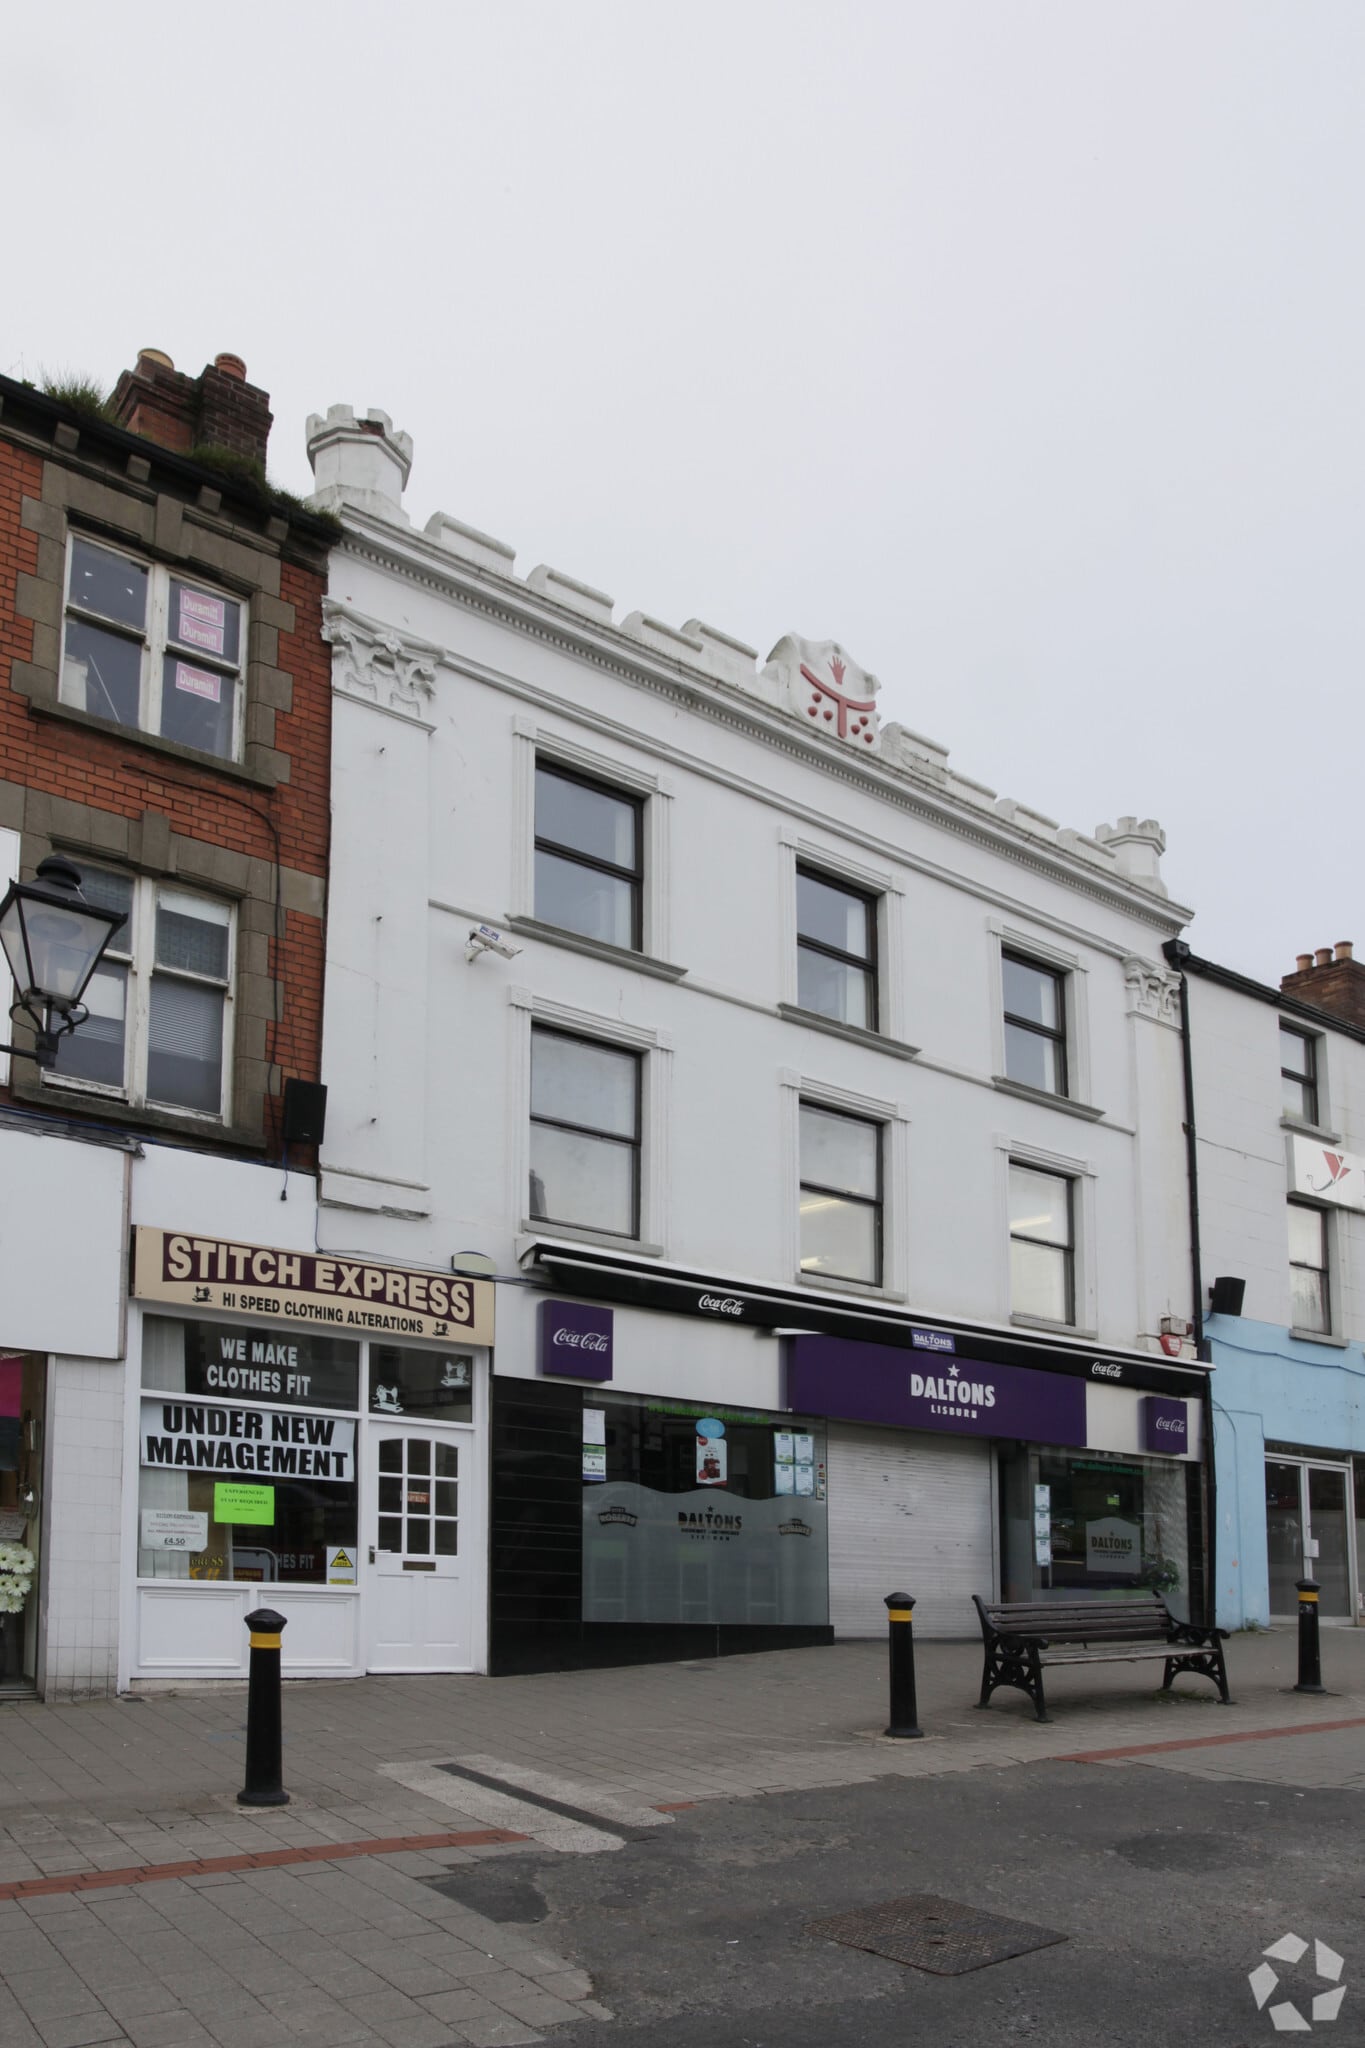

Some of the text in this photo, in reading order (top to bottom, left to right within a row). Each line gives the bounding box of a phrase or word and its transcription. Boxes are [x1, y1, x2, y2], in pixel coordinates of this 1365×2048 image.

[168, 1236, 470, 1322] STITCH EXPRESS
[223, 1292, 424, 1334] HI SPEED CLOTHING ALTERATIONS
[698, 1294, 744, 1315] Coca-Cola
[553, 1328, 609, 1352] Coca-Cola
[913, 1334, 953, 1347] DALTONS
[220, 1337, 298, 1368] WE MAKE
[207, 1365, 311, 1396] CLOTHES FIT
[1092, 1362, 1122, 1378] Coca-Cola
[911, 1373, 995, 1407] DALTONS
[931, 1404, 977, 1418] LISBURN
[163, 1405, 335, 1446] UNDER NEW
[1156, 1416, 1185, 1432] Coca-Cola
[147, 1435, 348, 1478] MANAGEMENT
[678, 1511, 742, 1530] DALTONS
[1091, 1536, 1132, 1550] DALTONS
